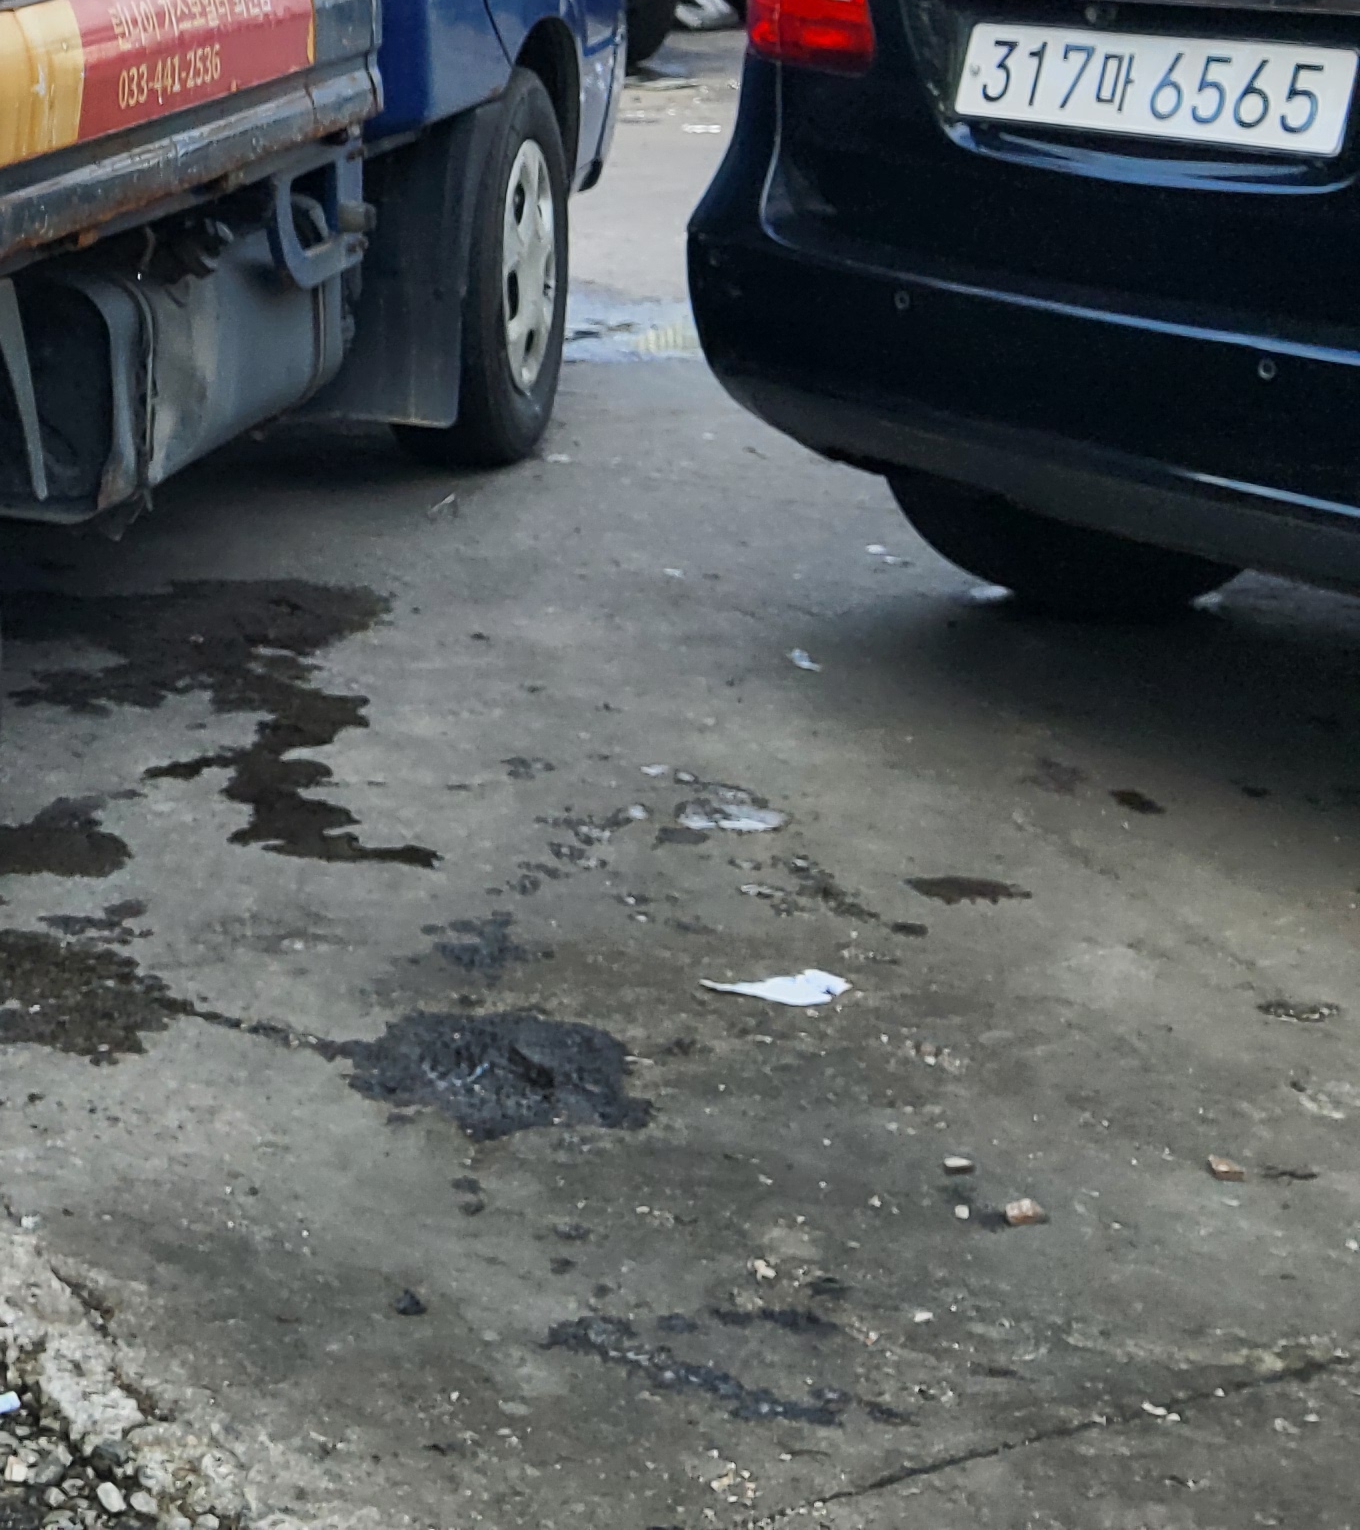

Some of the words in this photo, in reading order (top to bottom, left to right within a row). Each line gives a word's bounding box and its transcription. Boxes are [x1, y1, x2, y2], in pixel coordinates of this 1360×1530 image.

[117, 42, 222, 110] 033-441-2536
[982, 39, 1135, 112] 317마
[1149, 51, 1324, 134] 6565
